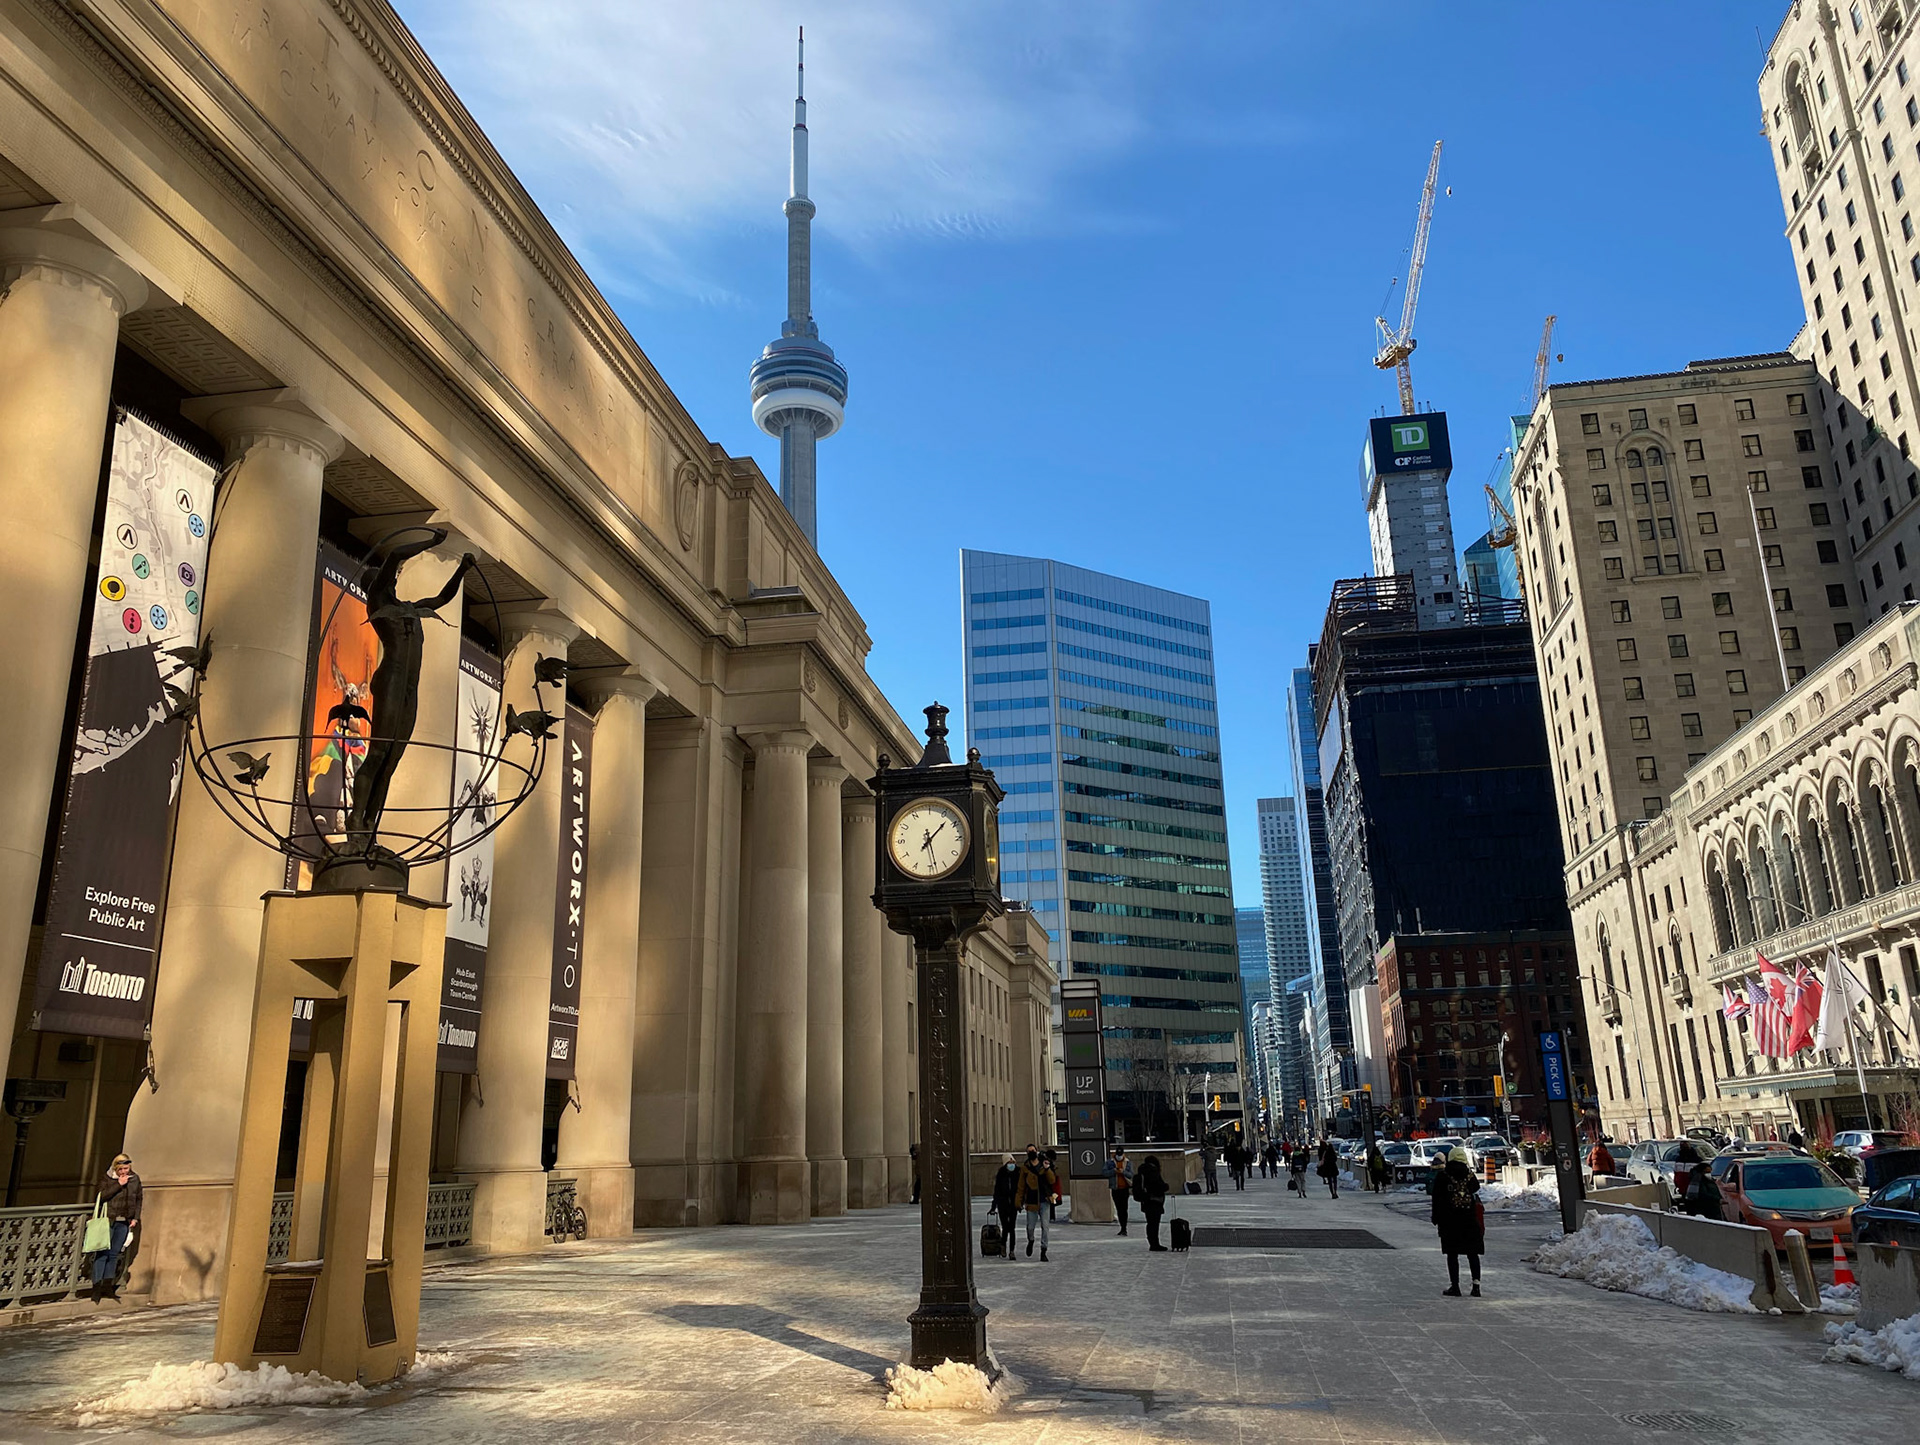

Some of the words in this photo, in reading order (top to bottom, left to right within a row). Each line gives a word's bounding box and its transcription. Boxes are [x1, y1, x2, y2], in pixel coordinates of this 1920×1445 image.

[1395, 426, 1425, 446] TD
[1394, 457, 1412, 467] CF
[85, 886, 130, 908] Explore
[131, 896, 156, 914] Free
[88, 907, 126, 928] Public
[126, 915, 146, 932] Art
[455, 967, 466, 977] Hub
[466, 969, 476, 979] East
[82, 963, 146, 1002] TORONTO
[450, 978, 478, 991] Scarborough
[449, 989, 462, 999] Town
[462, 991, 477, 1002] Centre
[1068, 1009, 1087, 1018] VIA
[447, 1023, 477, 1049] TORONTO
[1548, 1057, 1559, 1080] PICK
[1076, 1076, 1094, 1088] UP
[1551, 1083, 1562, 1096] UP
